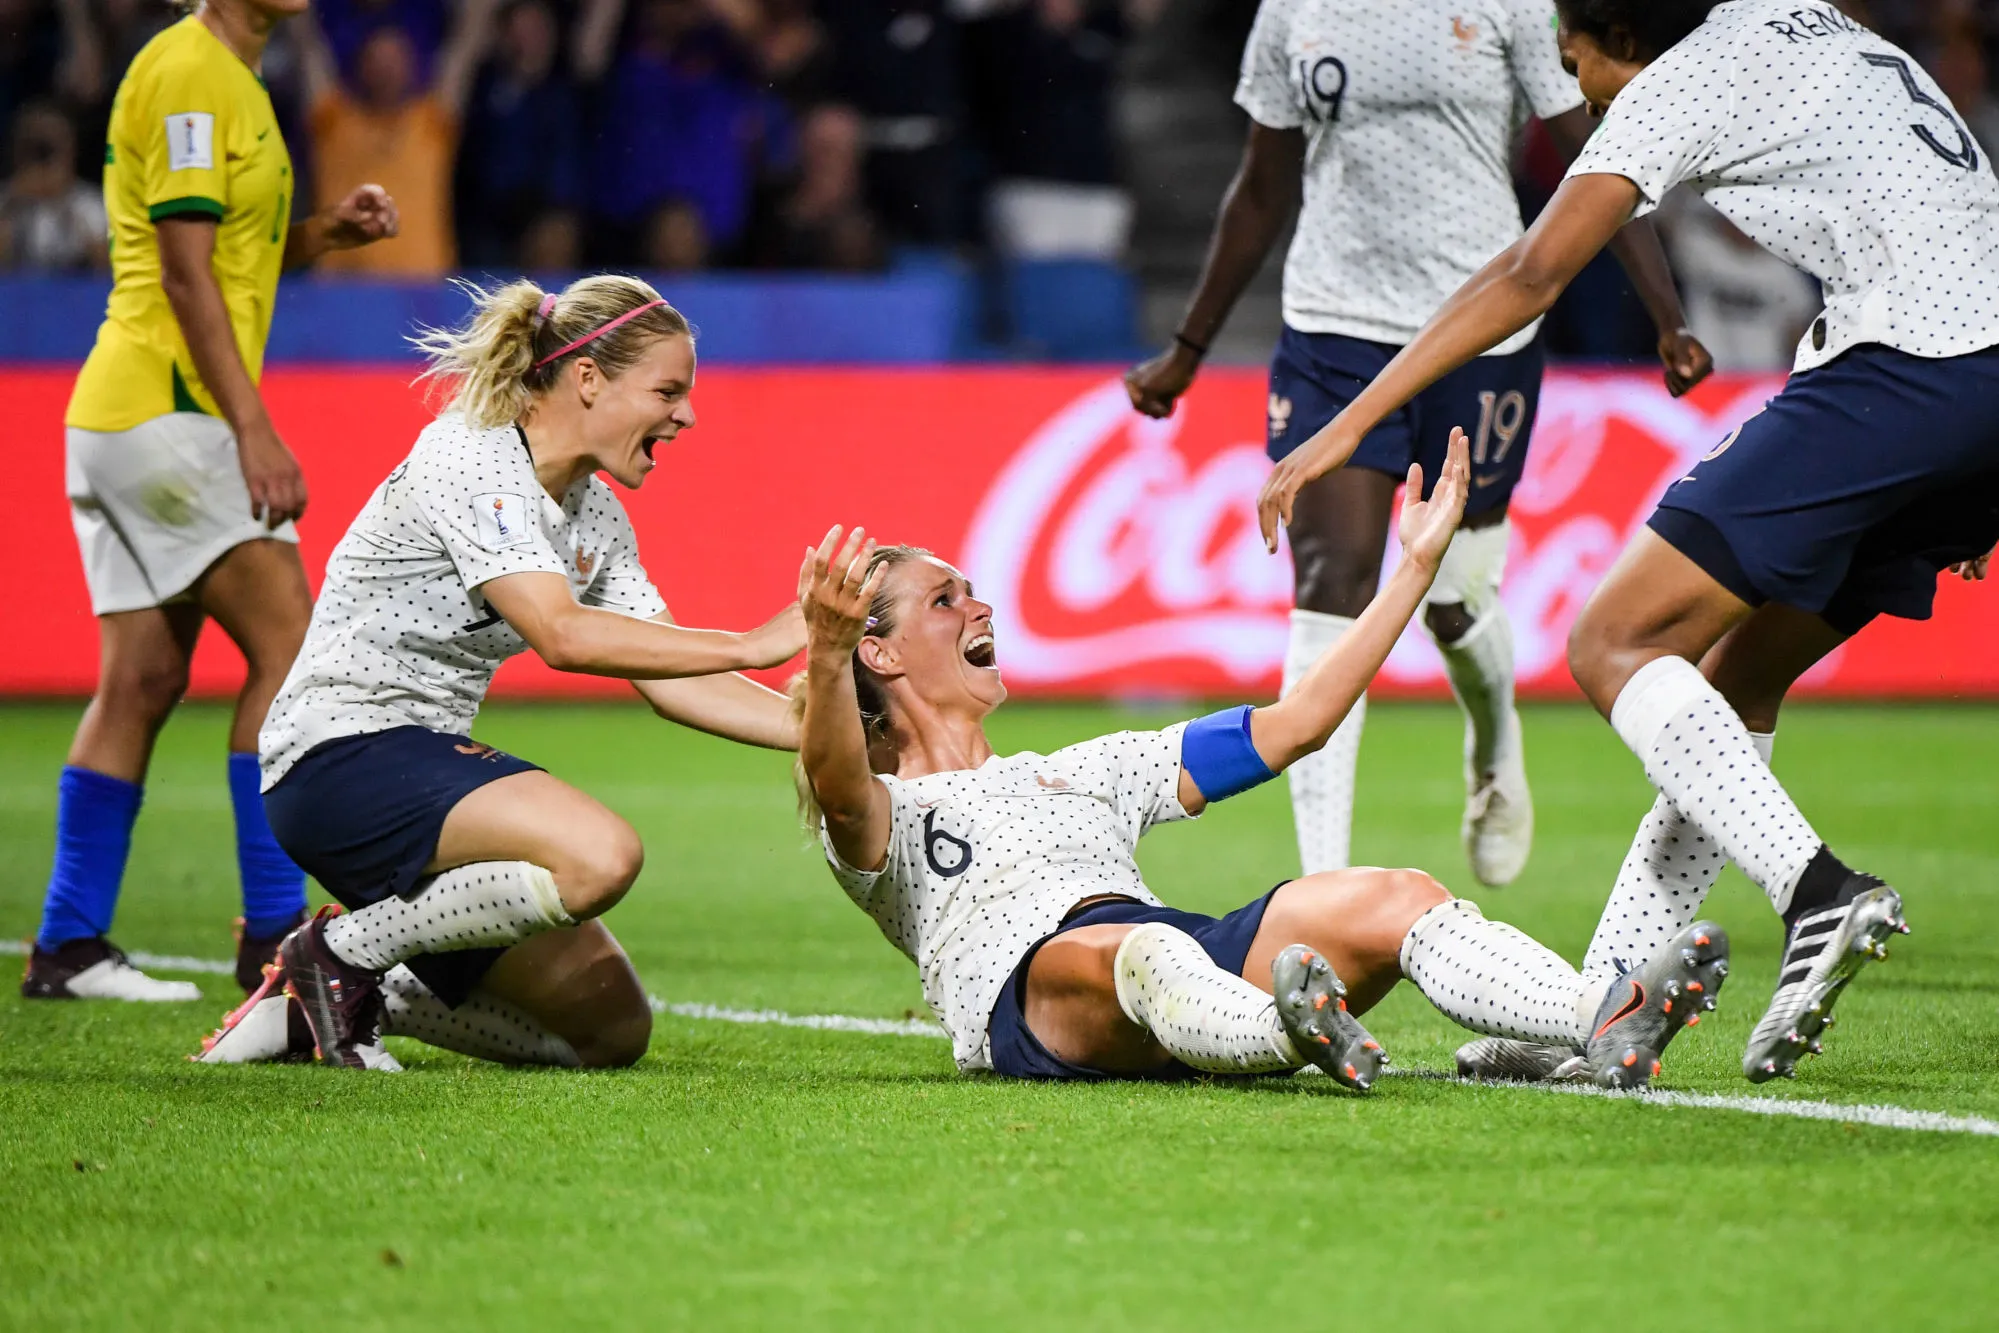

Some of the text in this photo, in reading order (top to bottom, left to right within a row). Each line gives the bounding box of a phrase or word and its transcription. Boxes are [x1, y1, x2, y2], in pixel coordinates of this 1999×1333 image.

[1300, 56, 1347, 122] 19
[1857, 51, 1979, 172] 3
[1473, 390, 1526, 464] 19
[924, 807, 972, 878] 6
